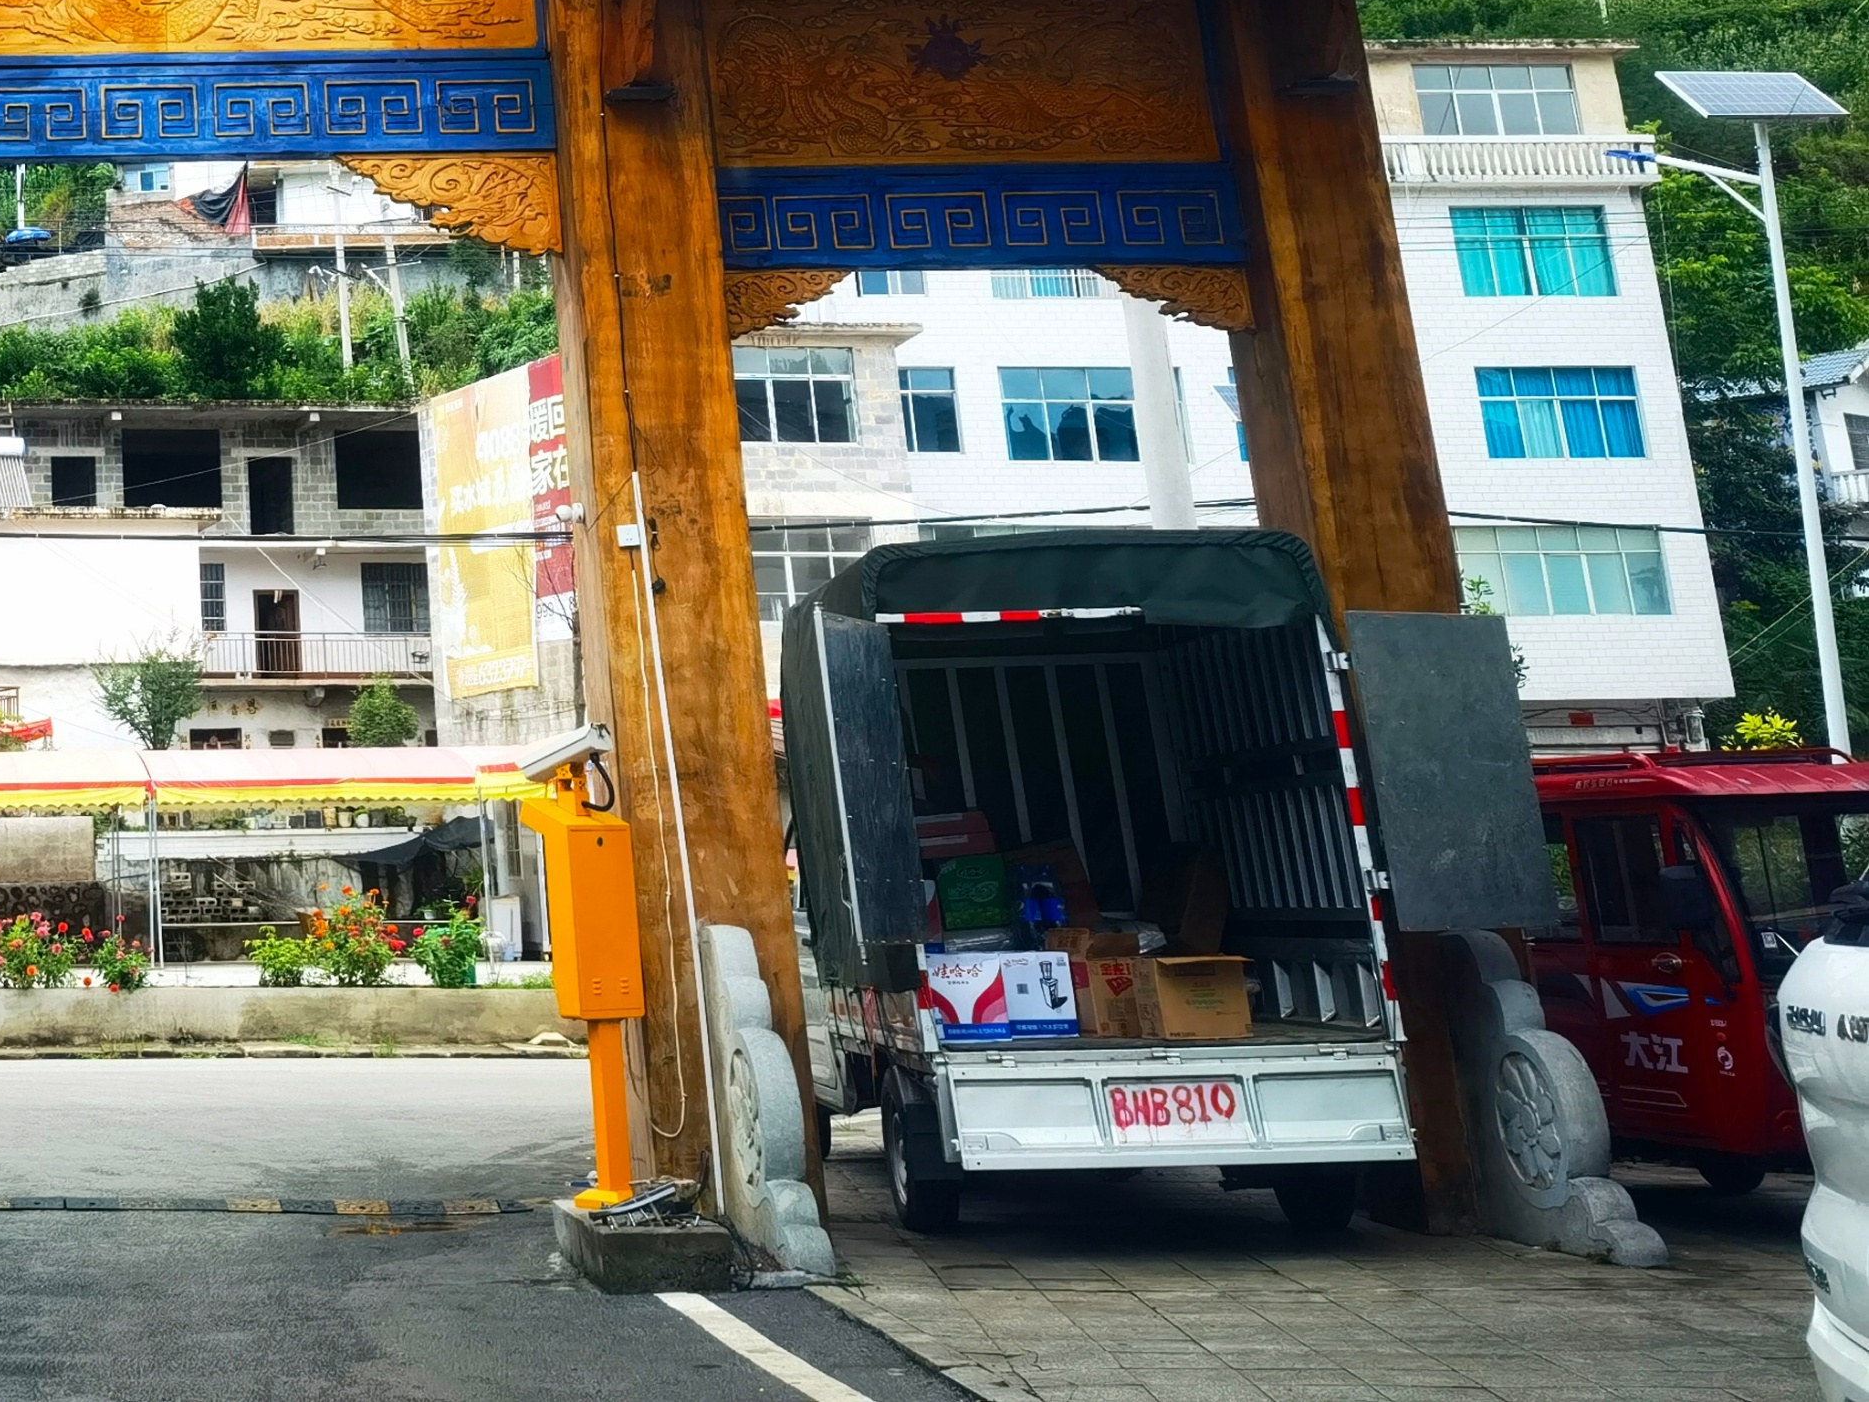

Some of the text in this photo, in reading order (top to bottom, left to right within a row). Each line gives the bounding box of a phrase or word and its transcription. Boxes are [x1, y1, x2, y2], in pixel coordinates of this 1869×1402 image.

[932, 962, 983, 979] 娃哈哈
[1620, 1030, 1689, 1074] 大江
[1110, 1083, 1236, 1129] BHB810
